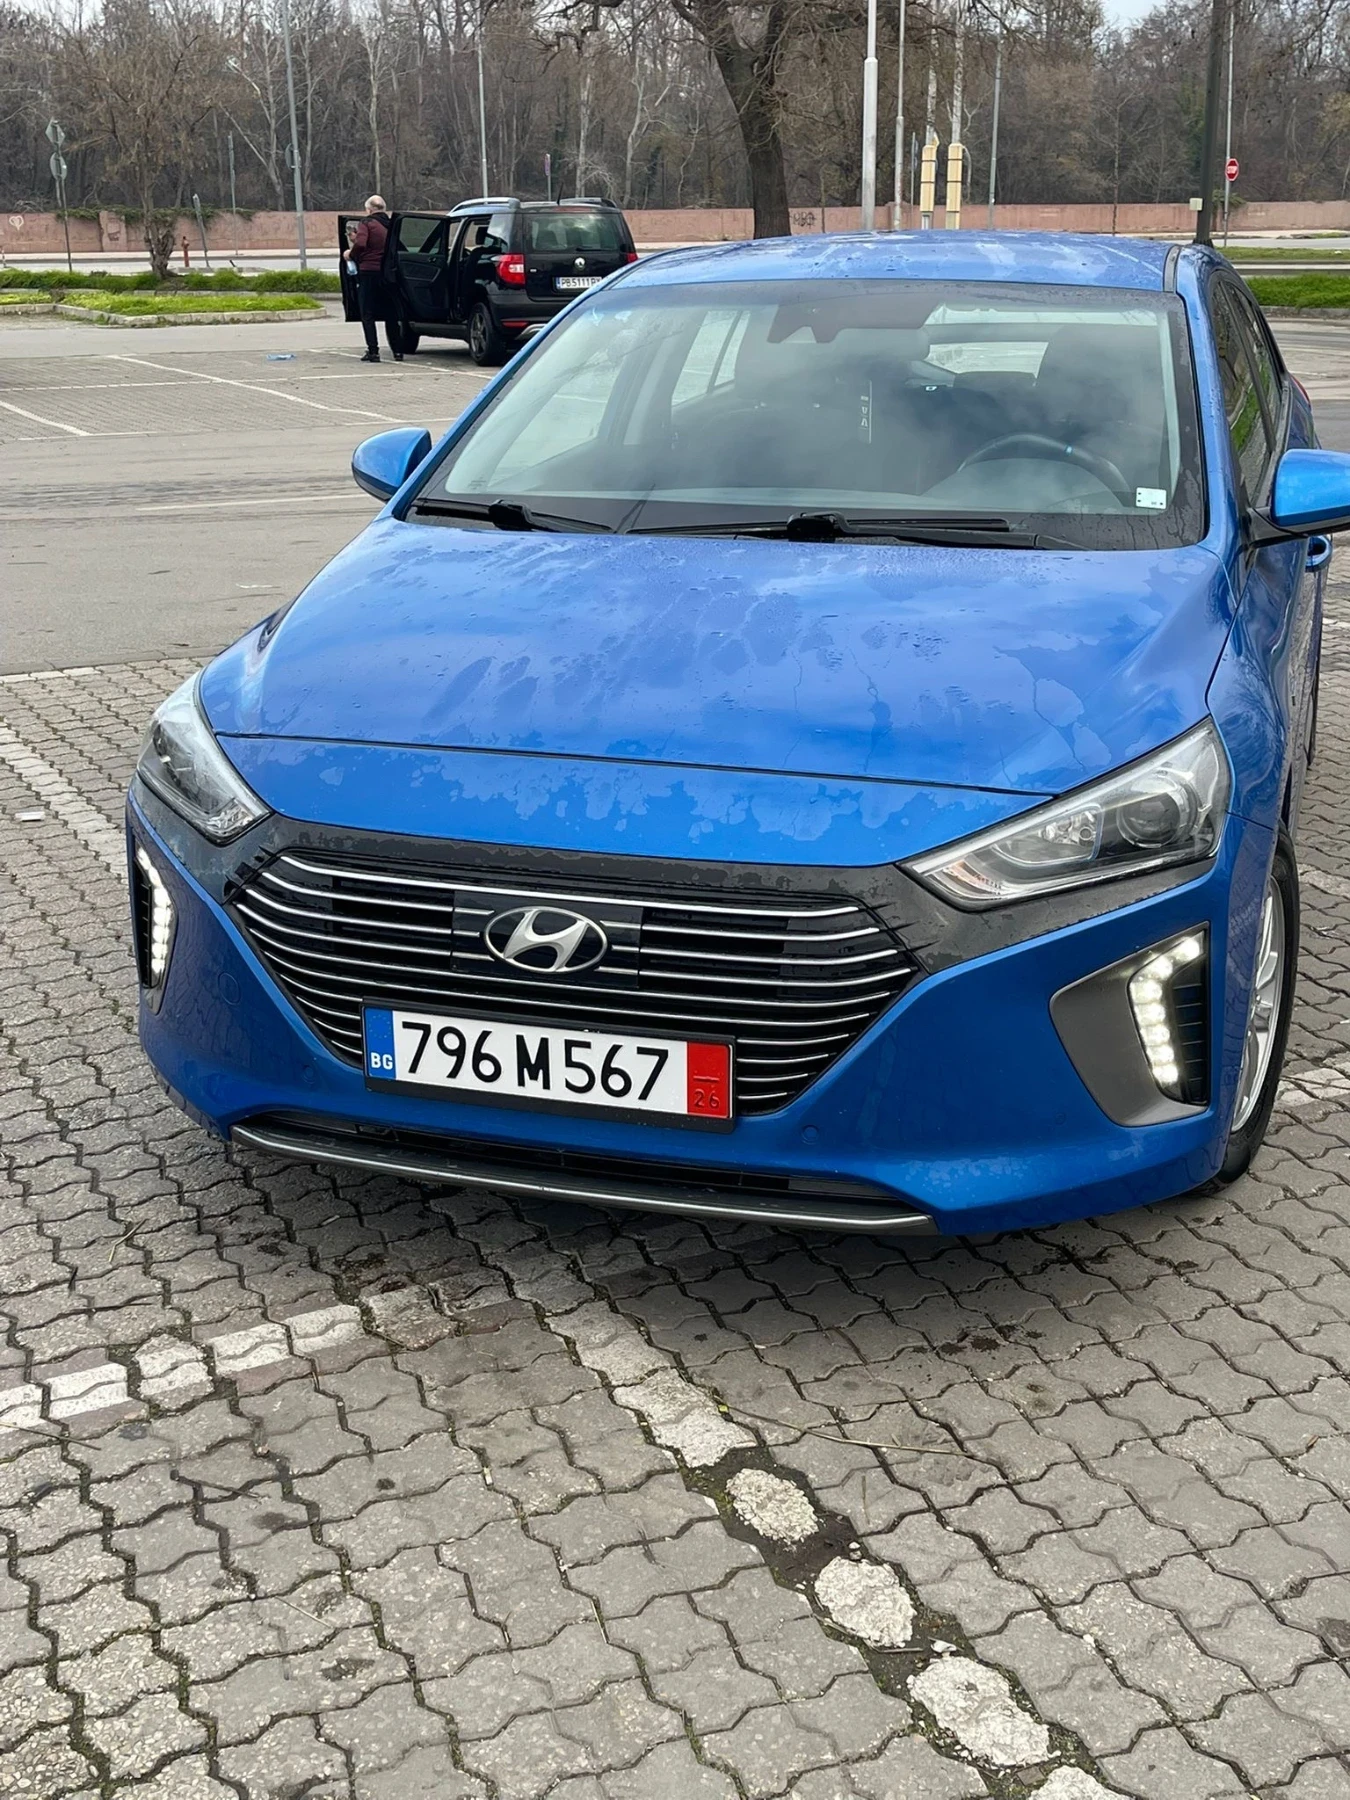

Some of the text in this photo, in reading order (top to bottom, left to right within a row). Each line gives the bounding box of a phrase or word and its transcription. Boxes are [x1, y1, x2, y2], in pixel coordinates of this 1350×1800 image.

[370, 1051, 394, 1071] BG
[401, 1021, 669, 1101] 796 M 567
[694, 1088, 720, 1110] 26
